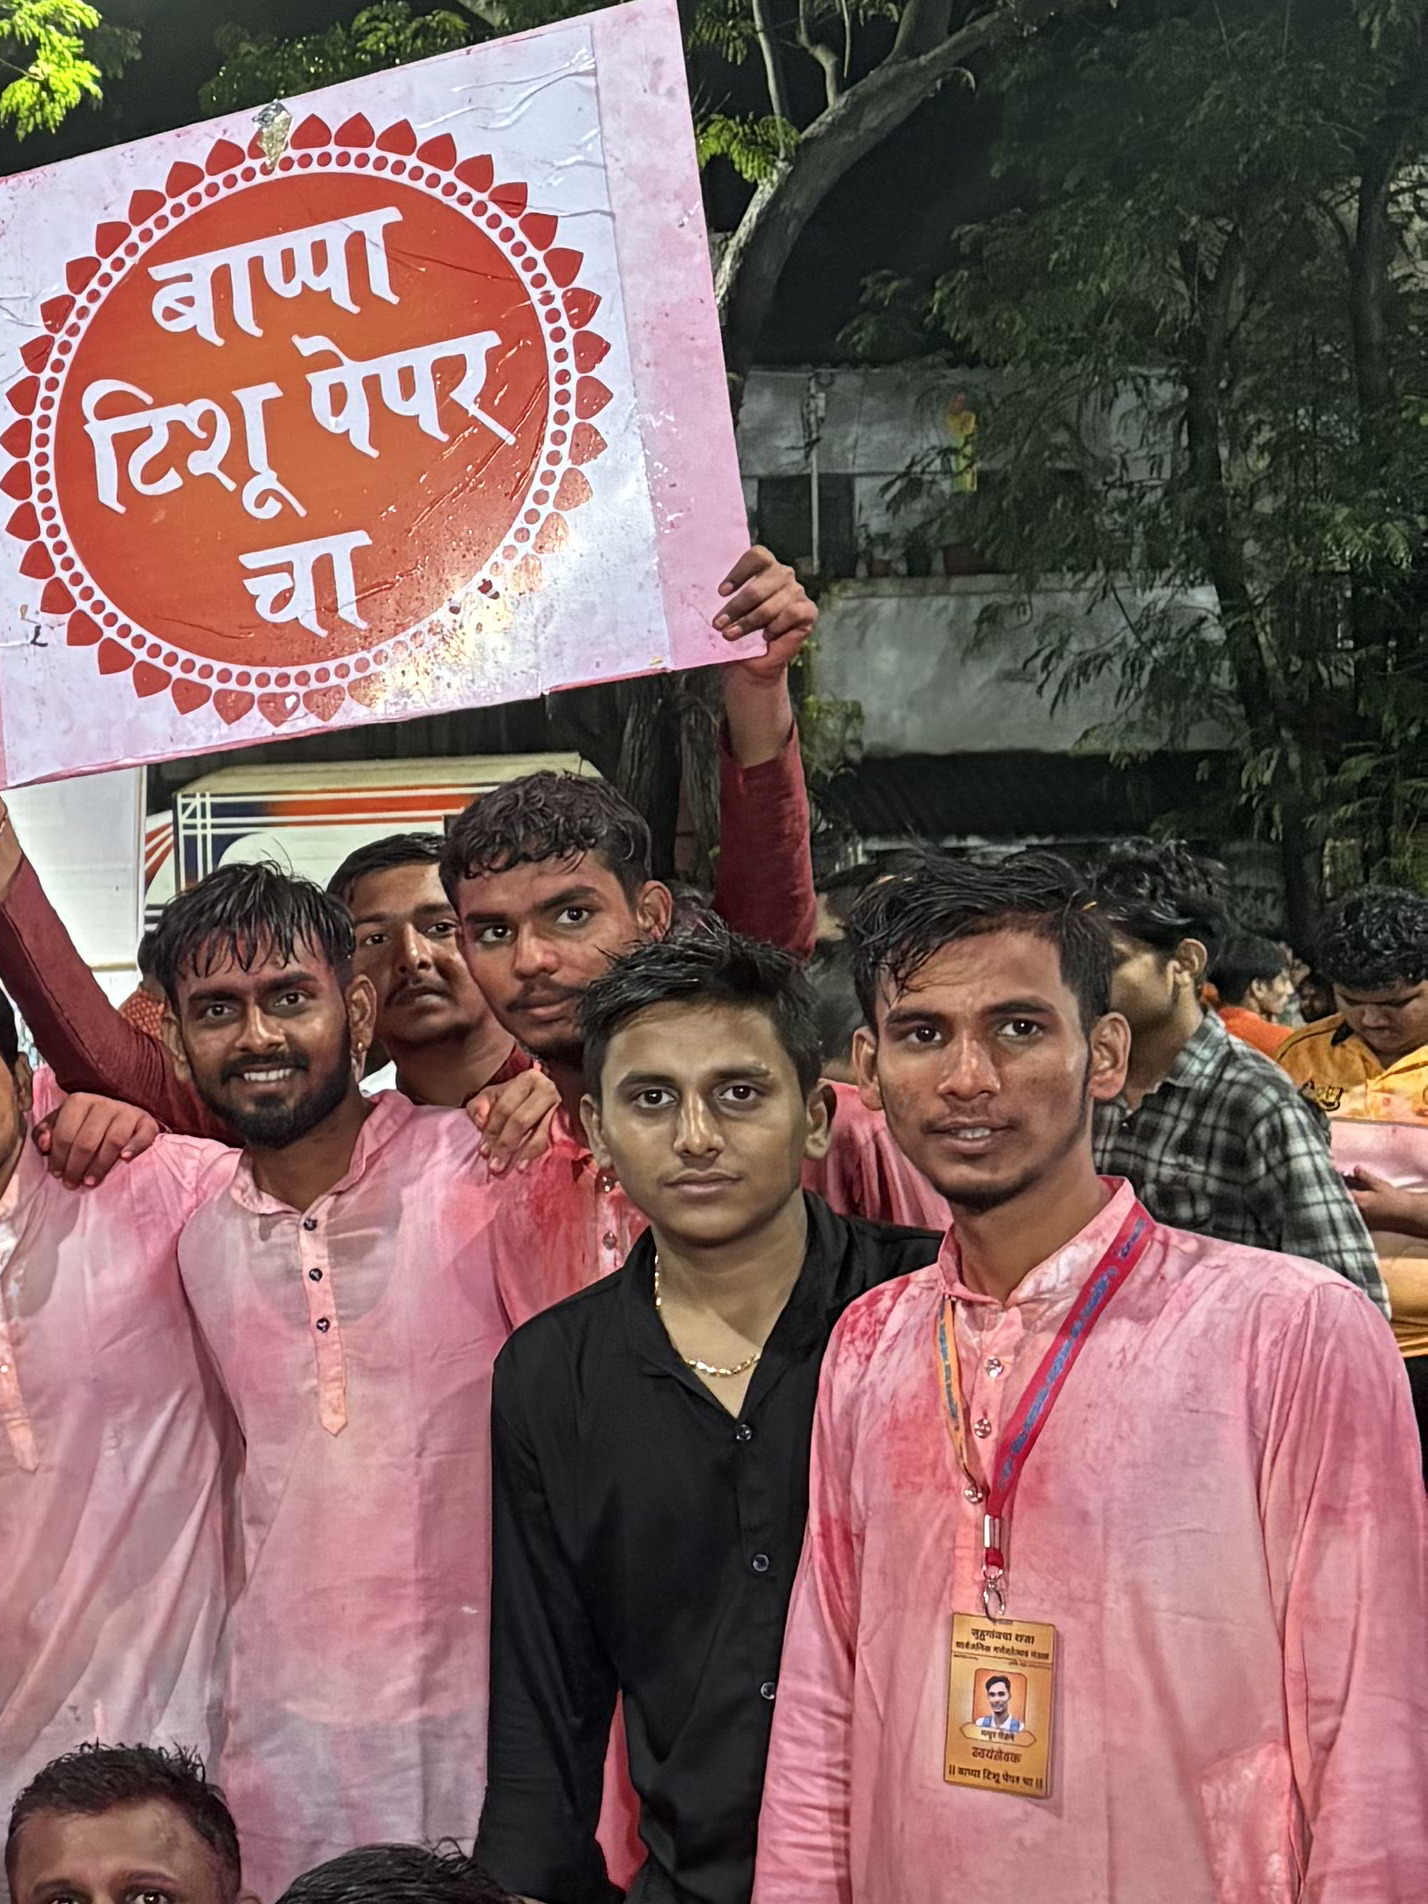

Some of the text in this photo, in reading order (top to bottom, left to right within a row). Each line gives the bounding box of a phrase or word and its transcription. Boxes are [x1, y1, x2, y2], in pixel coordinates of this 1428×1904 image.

[147, 205, 404, 347] बाप्पा
[81, 329, 517, 520] टिशू पेपर
[238, 529, 374, 639] चा
